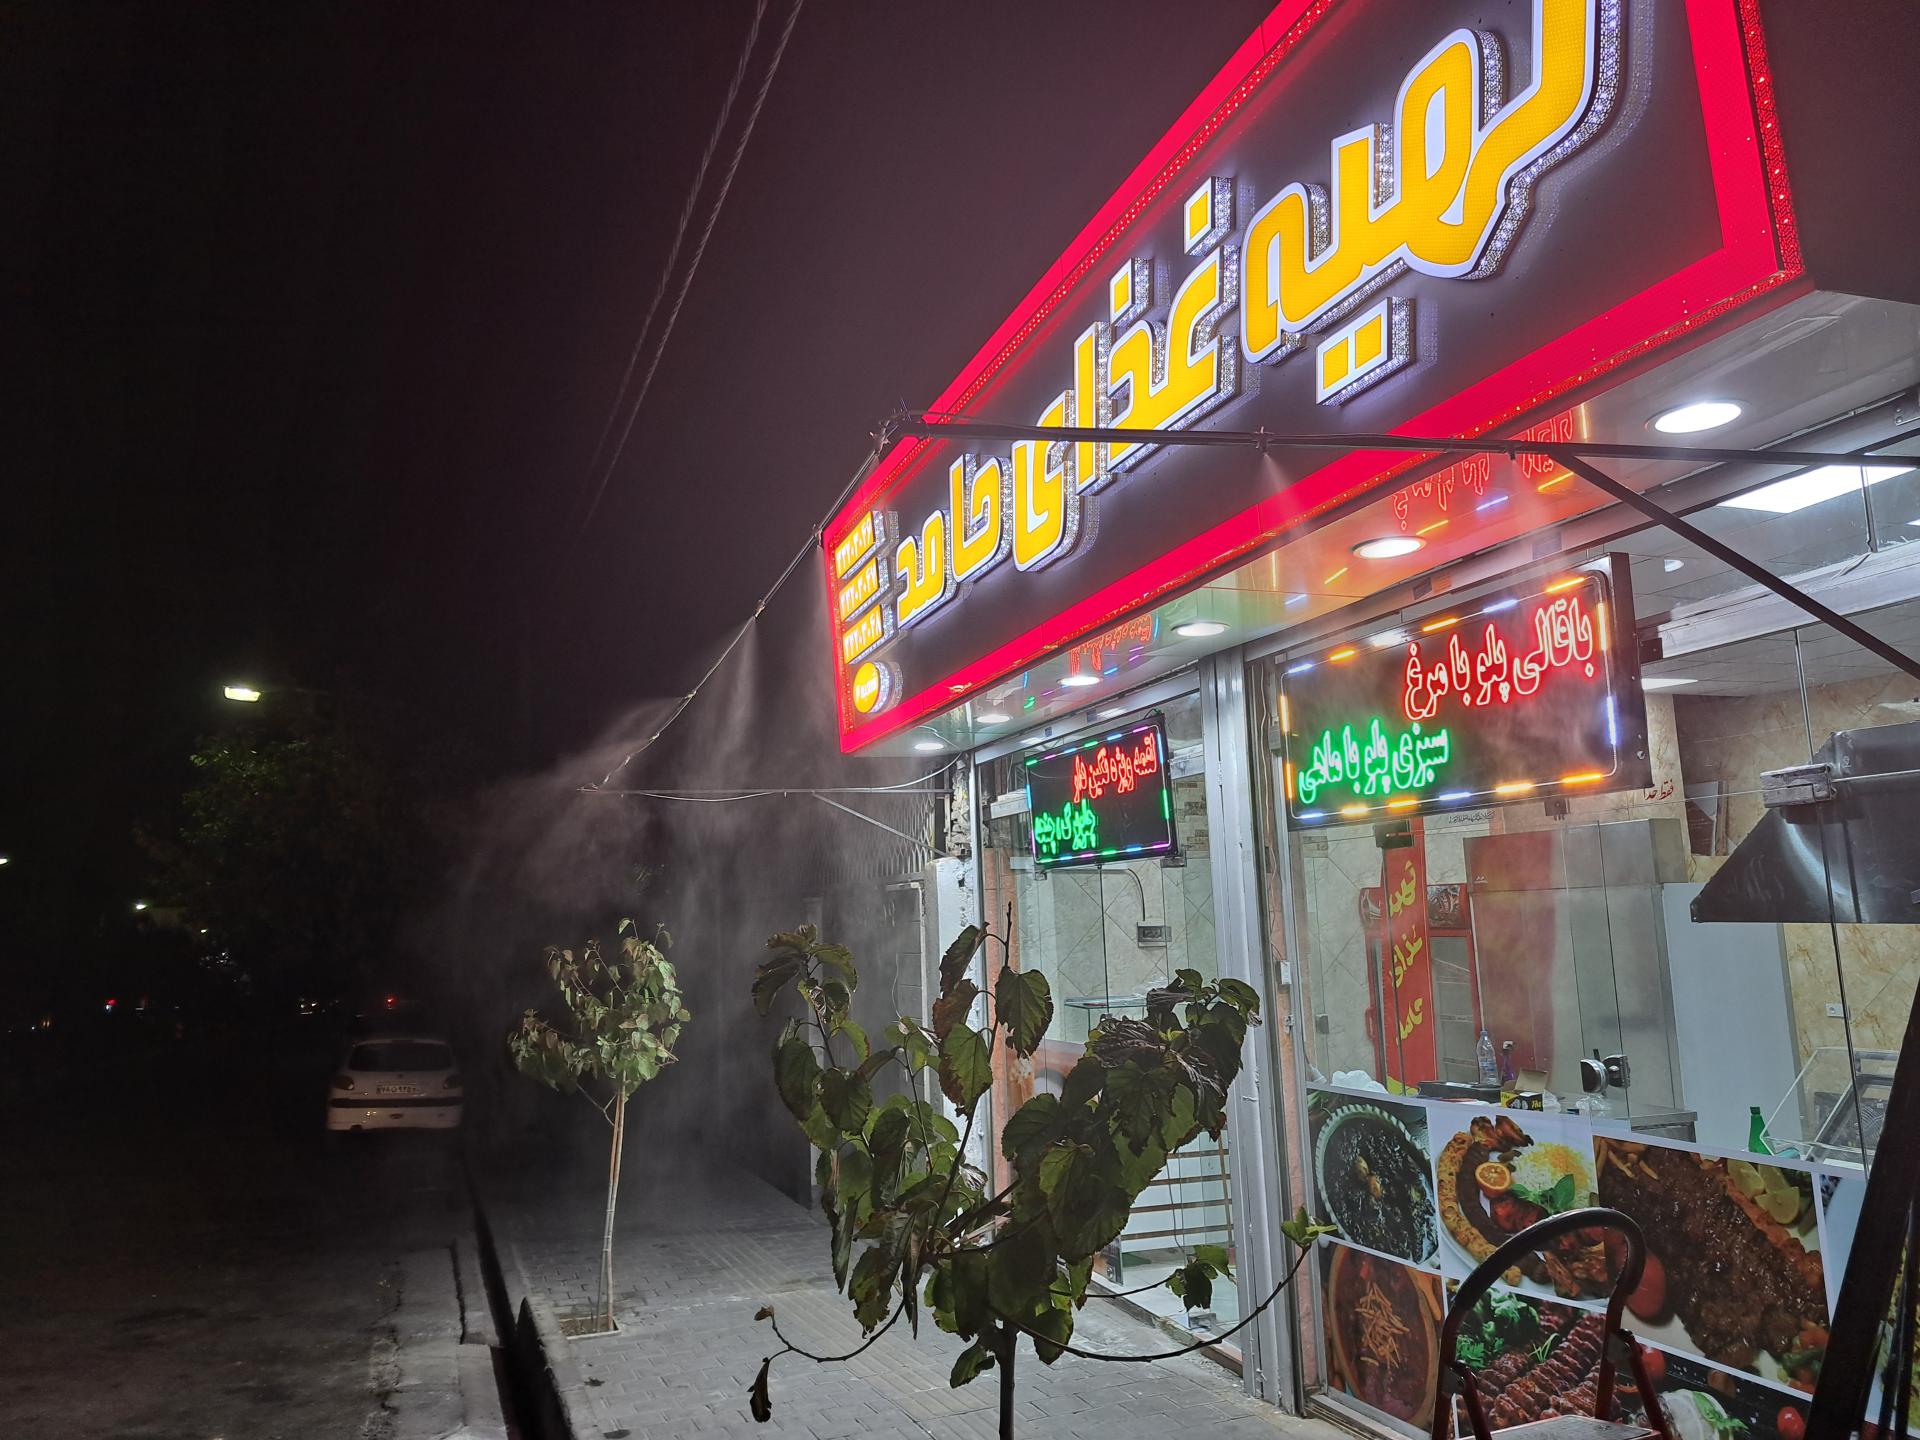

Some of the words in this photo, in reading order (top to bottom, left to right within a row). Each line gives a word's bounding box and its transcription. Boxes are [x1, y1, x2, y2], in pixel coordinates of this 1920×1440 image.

[896, 453, 1001, 630] حامد
[1404, 642, 1449, 721] مرغ
[1449, 634, 1471, 706] با
[1476, 623, 1507, 706] پلو
[1513, 597, 1593, 695] باقالی
[1298, 730, 1343, 804] ماهی
[1342, 725, 1360, 793] با
[1363, 719, 1389, 795] پلو
[1392, 723, 1450, 789] سبزی
[1659, 779, 1674, 801] فقط
